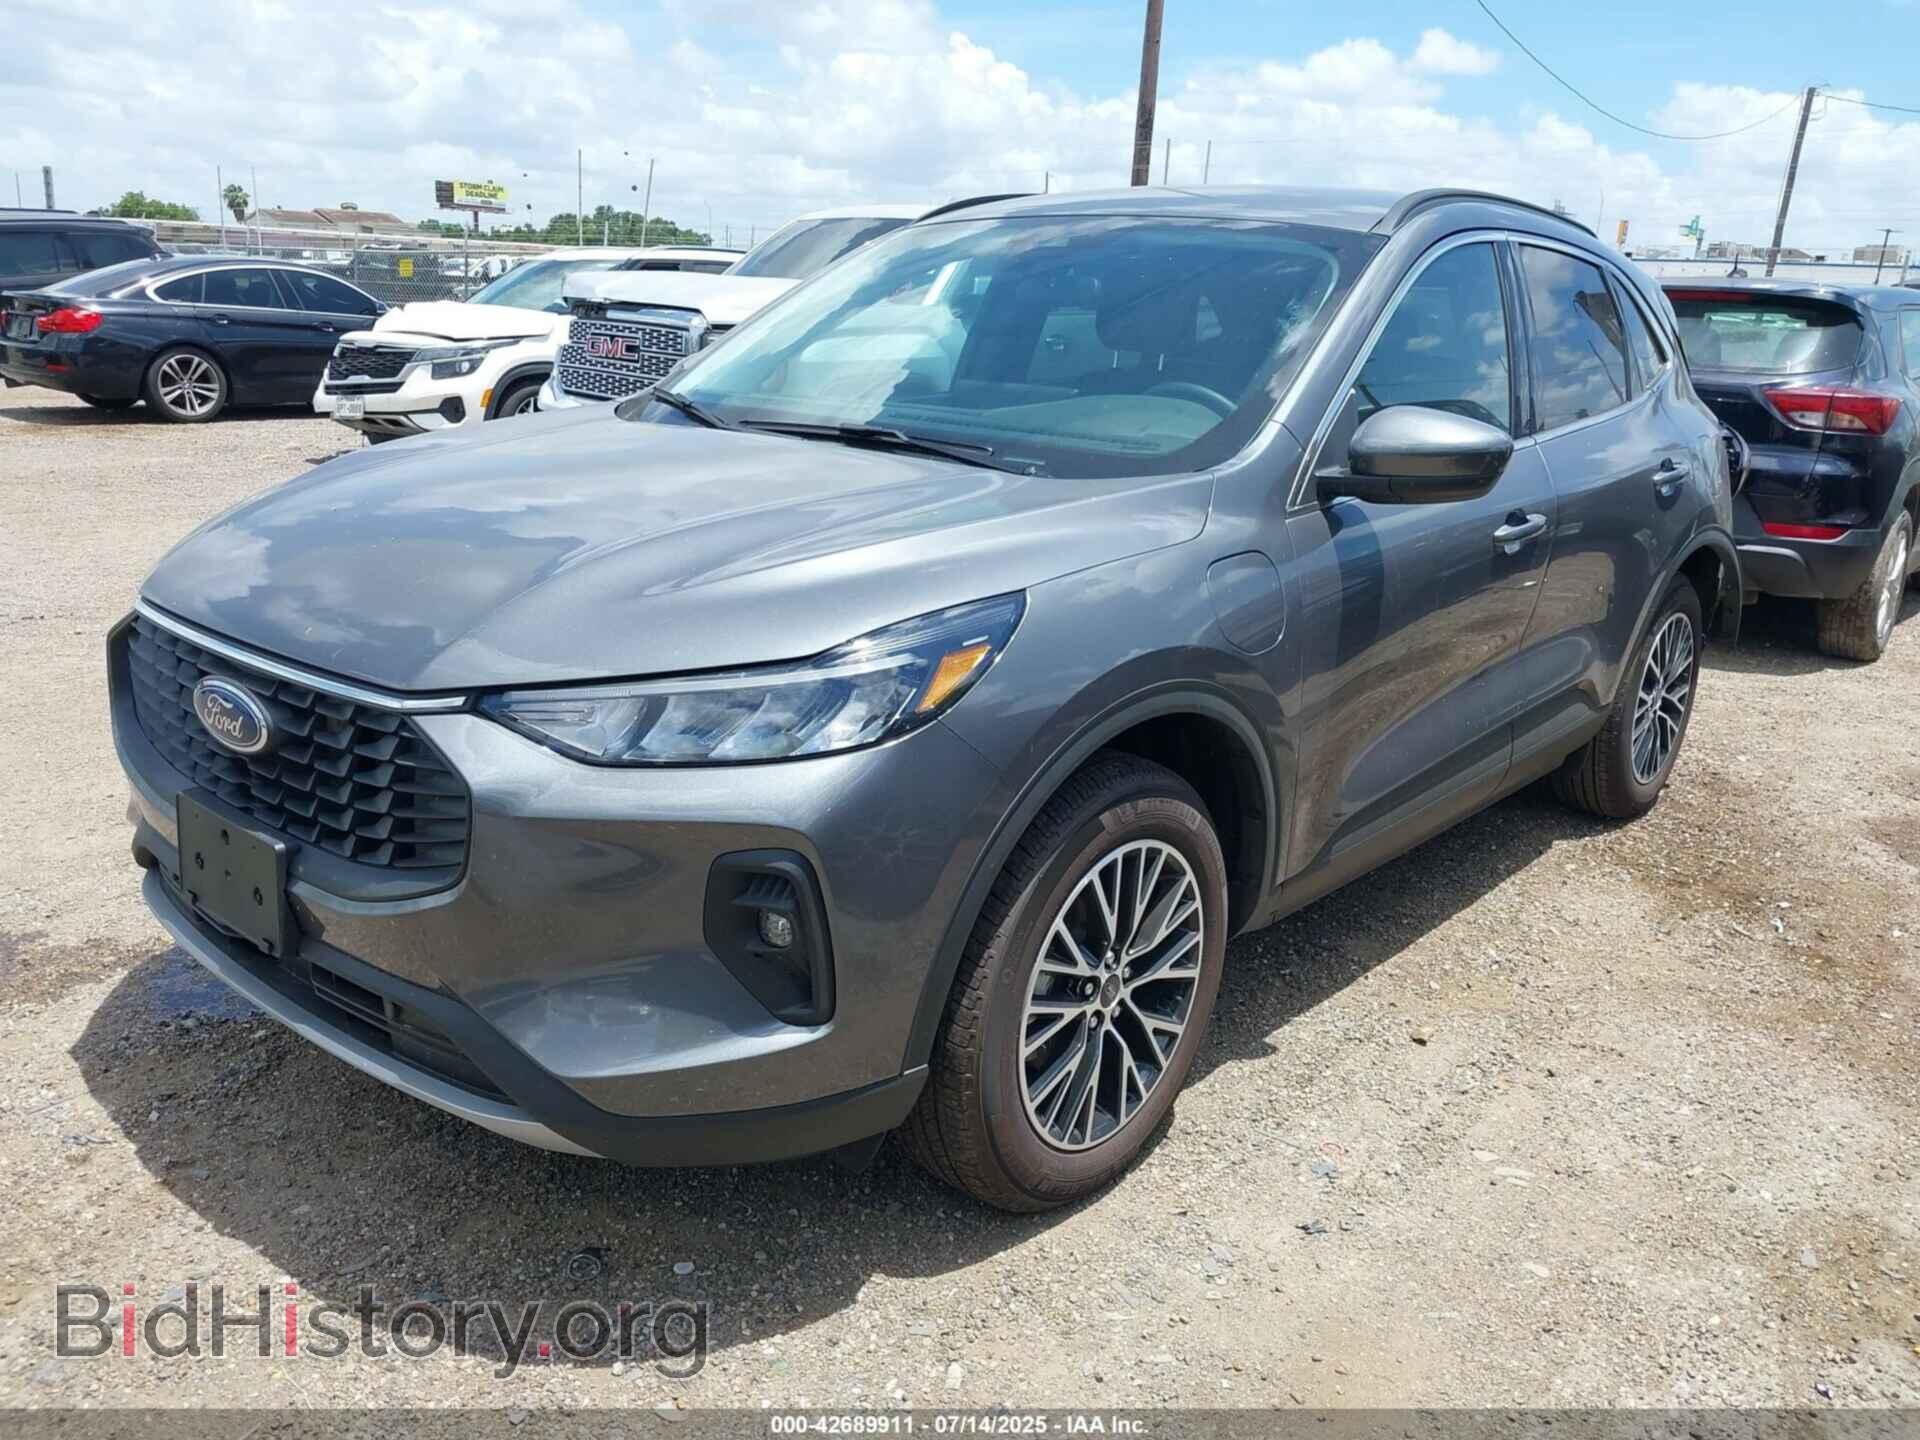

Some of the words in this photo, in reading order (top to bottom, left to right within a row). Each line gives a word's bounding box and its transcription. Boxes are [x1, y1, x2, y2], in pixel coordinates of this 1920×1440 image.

[459, 182, 482, 190] STORM
[484, 184, 504, 193] CLAIM
[464, 190, 498, 199] DEADLINE
[587, 336, 639, 360] GMC
[203, 694, 244, 738] Ford
